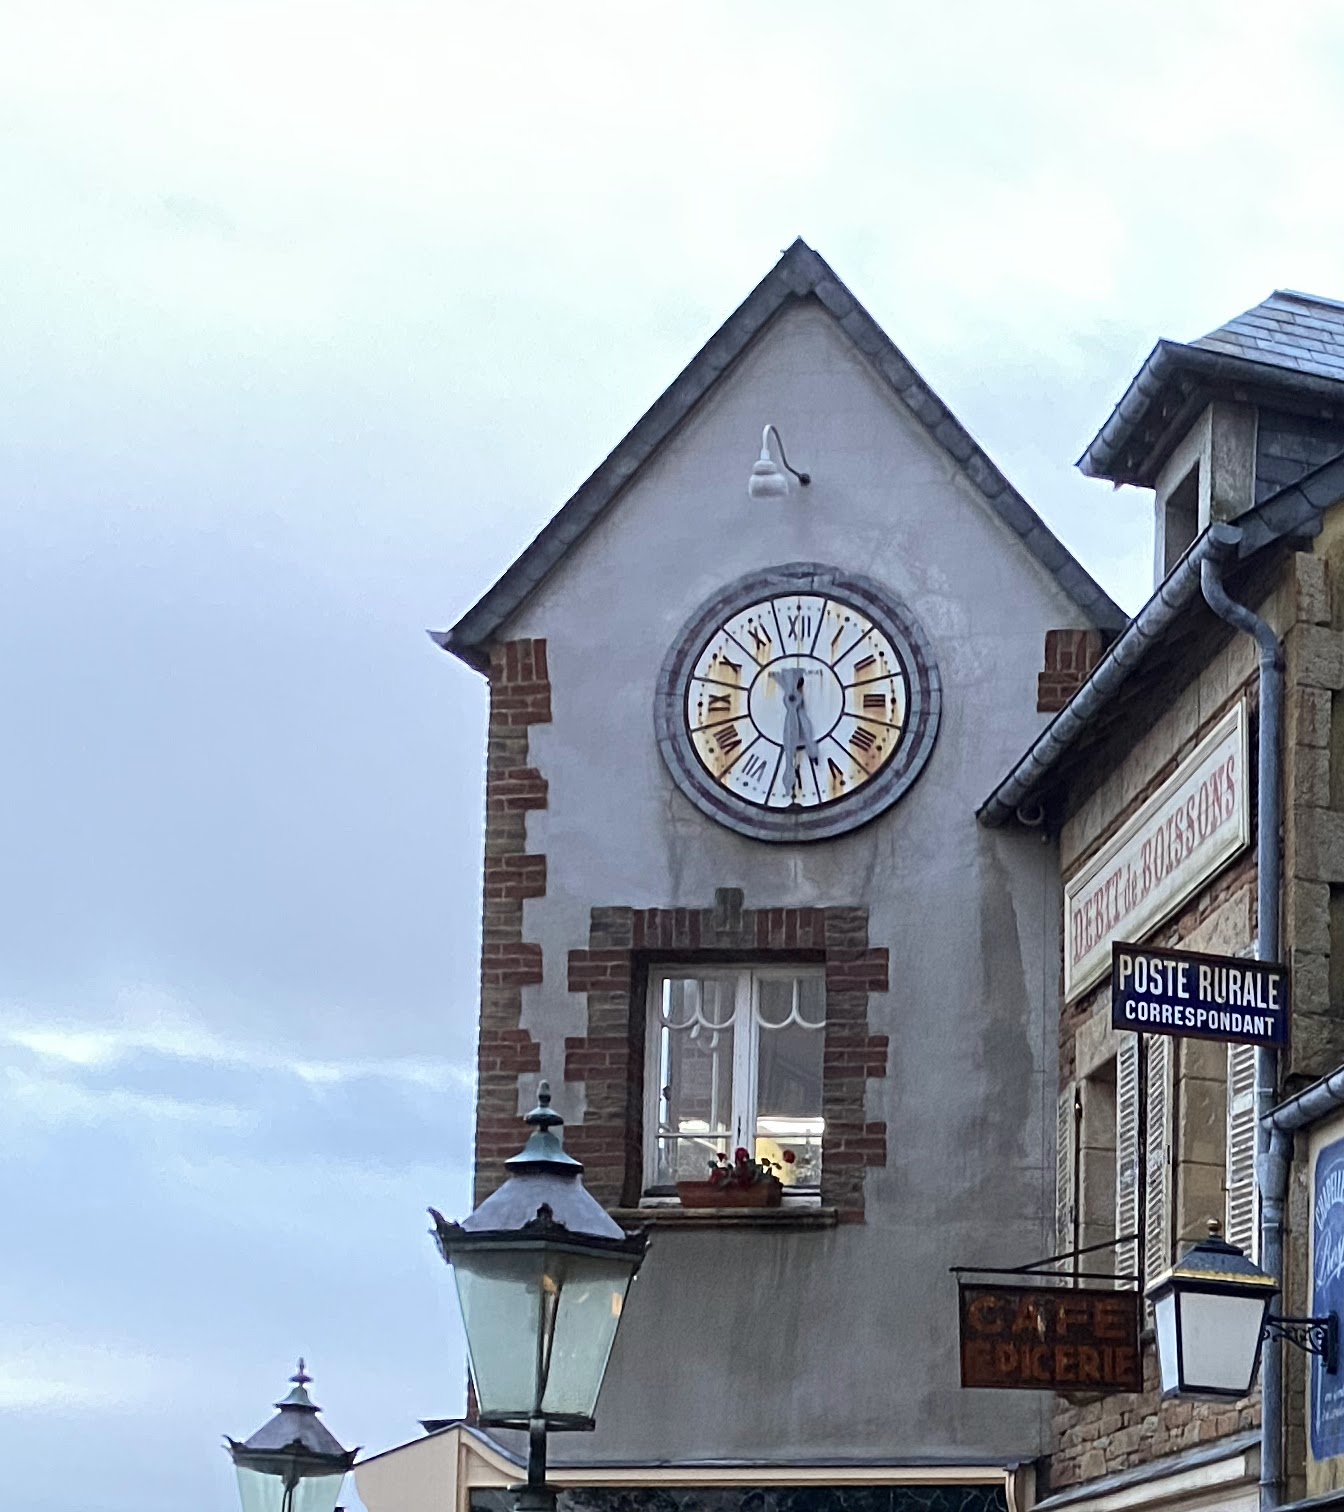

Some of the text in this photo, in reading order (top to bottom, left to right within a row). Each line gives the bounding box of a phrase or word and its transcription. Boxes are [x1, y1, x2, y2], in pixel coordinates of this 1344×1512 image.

[1140, 755, 1235, 897] BOISSONS
[1118, 954, 1281, 1010] POSTE RURALE
[1125, 999, 1275, 1037] CORRESPONDANT
